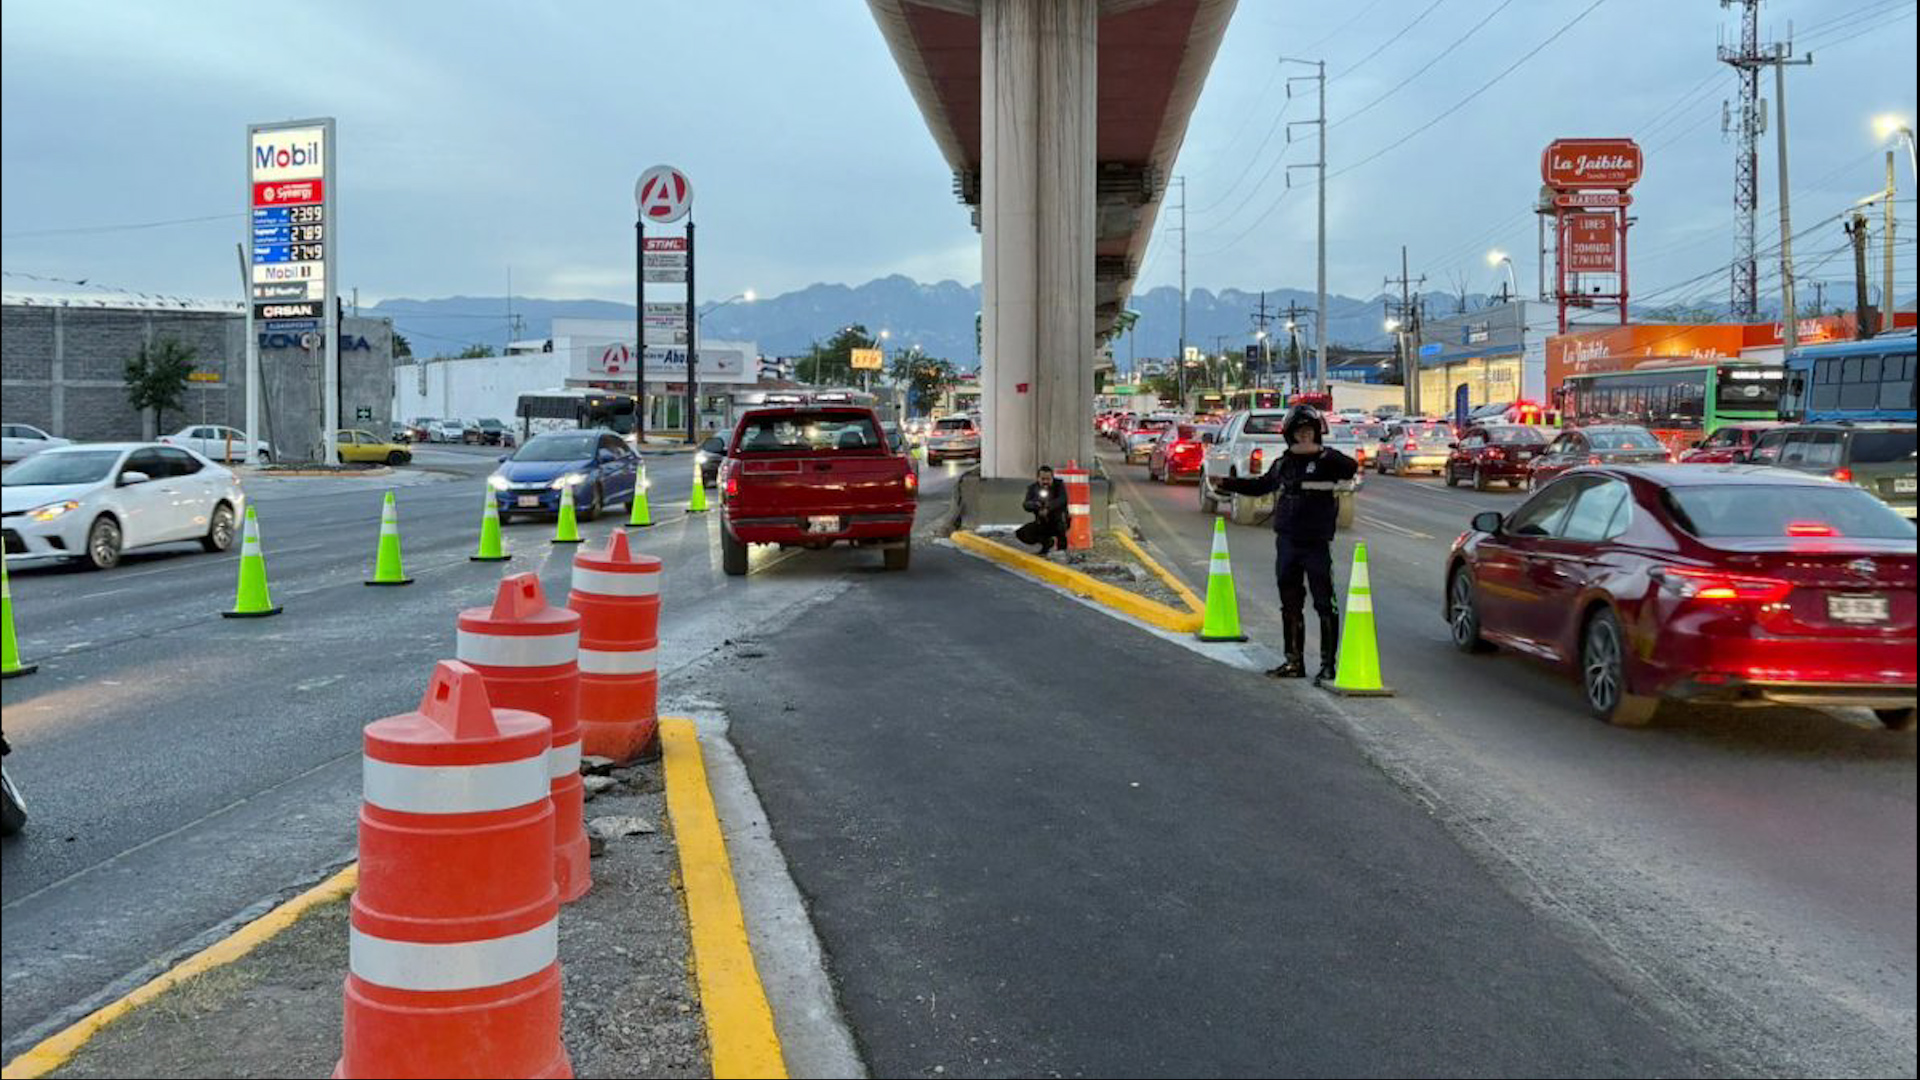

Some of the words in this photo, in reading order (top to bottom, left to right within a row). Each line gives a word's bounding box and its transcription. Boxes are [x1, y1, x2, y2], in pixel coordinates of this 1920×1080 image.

[256, 141, 318, 169] Mobil
[1553, 155, 1573, 170] La
[1575, 155, 1634, 175] Jaibita
[276, 186, 313, 201] Synergy
[1569, 195, 1619, 205] MARISCOS
[1580, 218, 1606, 230] LUNES
[646, 239, 683, 250] STIHL
[265, 266, 298, 280] Mobil
[263, 305, 313, 317] ORSAN
